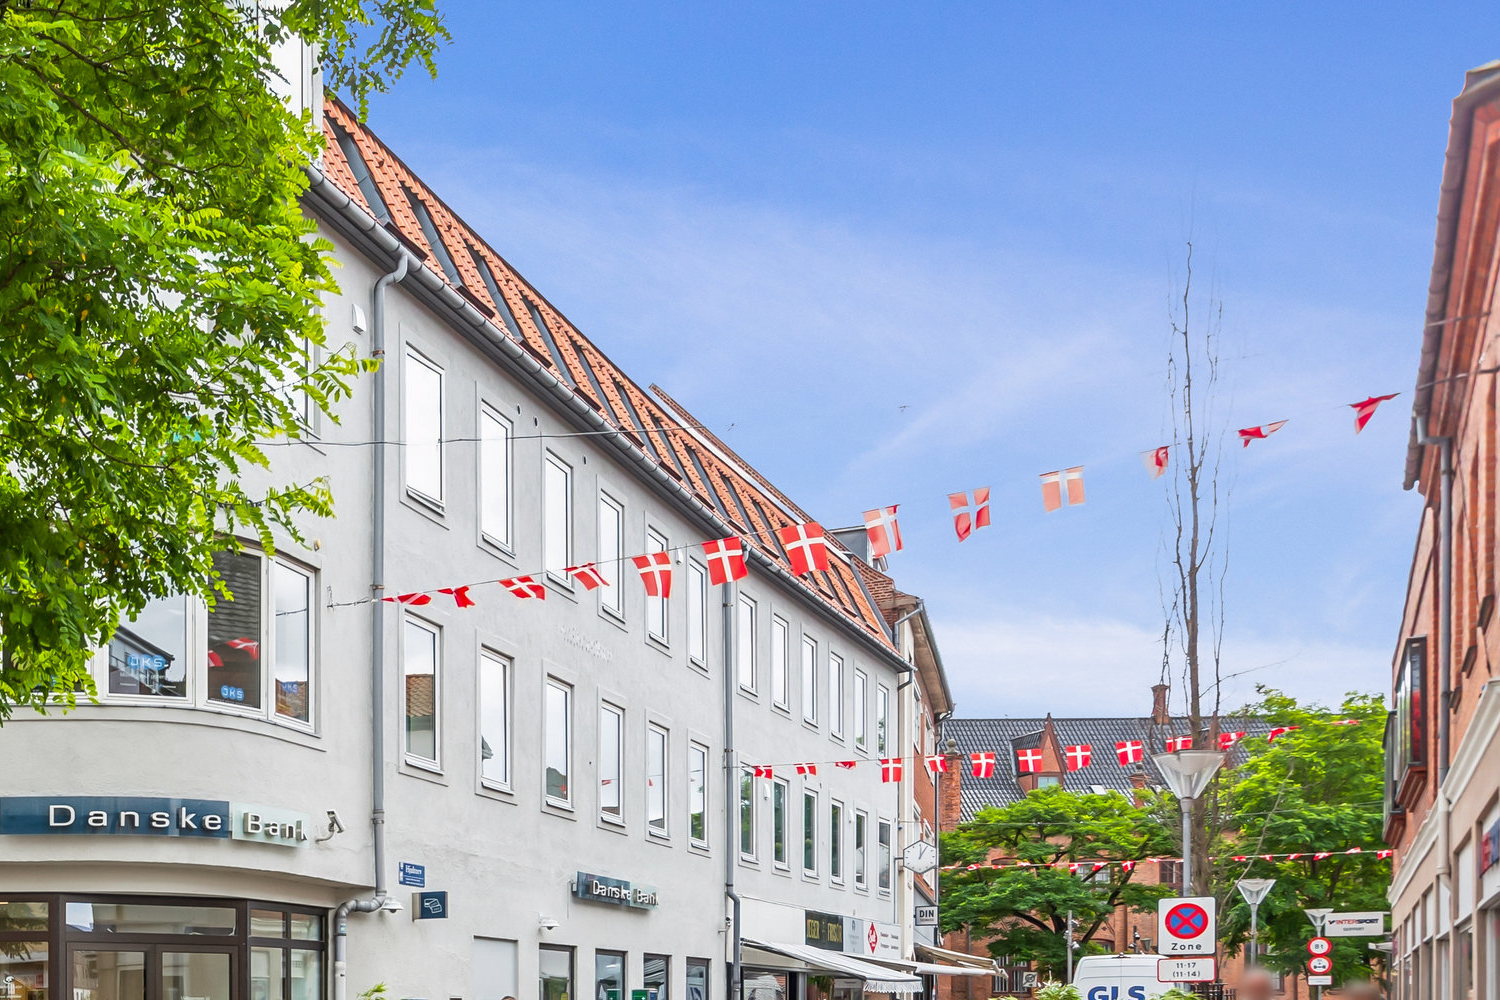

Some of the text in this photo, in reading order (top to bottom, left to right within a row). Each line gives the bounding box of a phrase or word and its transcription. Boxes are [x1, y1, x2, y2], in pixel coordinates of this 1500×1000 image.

[130, 656, 163, 668] JKS
[222, 686, 243, 699] JKS
[49, 804, 308, 841] Danske Bank
[592, 880, 631, 900] Danske
[919, 909, 935, 918] DIN
[1171, 943, 1202, 951] Zone
